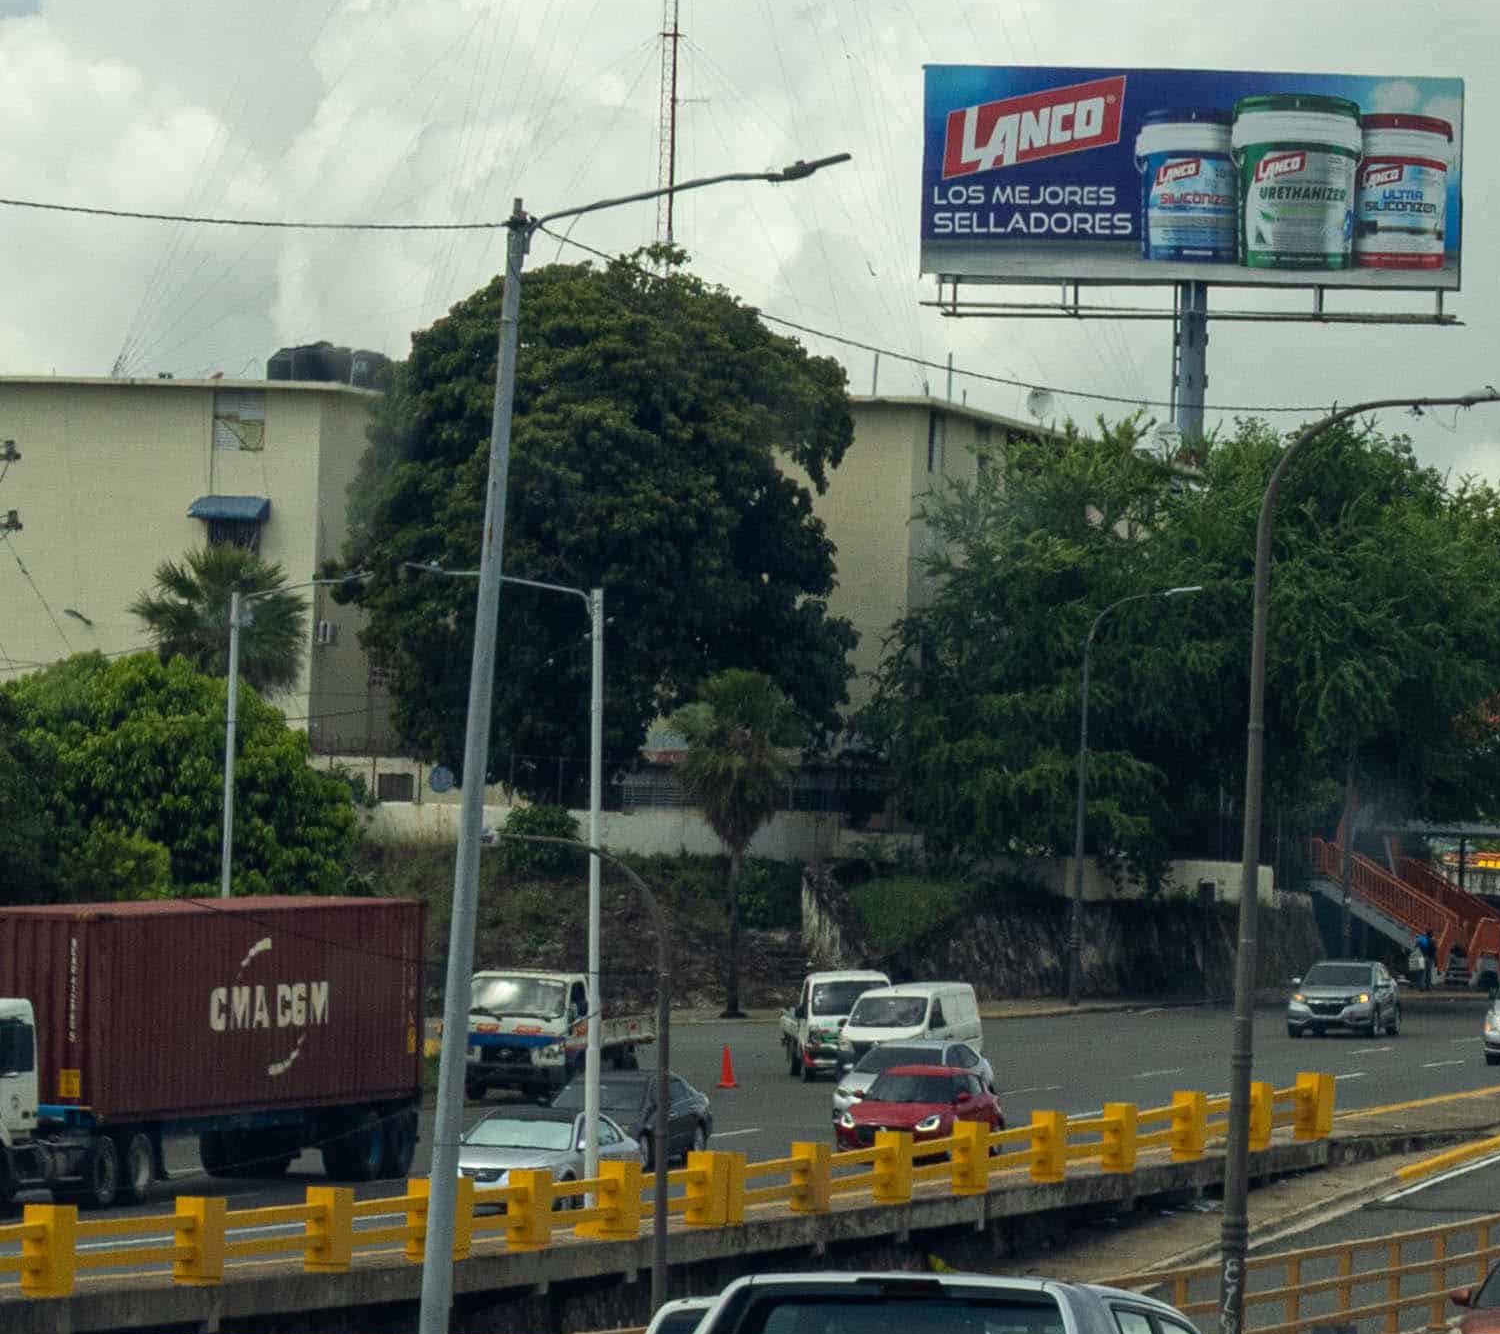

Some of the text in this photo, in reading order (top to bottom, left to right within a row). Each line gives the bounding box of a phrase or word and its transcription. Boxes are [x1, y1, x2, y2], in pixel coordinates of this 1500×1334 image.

[961, 97, 1106, 171] LANCO
[1257, 156, 1301, 181] LANCO
[934, 186, 1116, 205] LOS MEJORES
[934, 213, 1133, 234] SELLADORES
[210, 981, 330, 1032] CMA CGM
